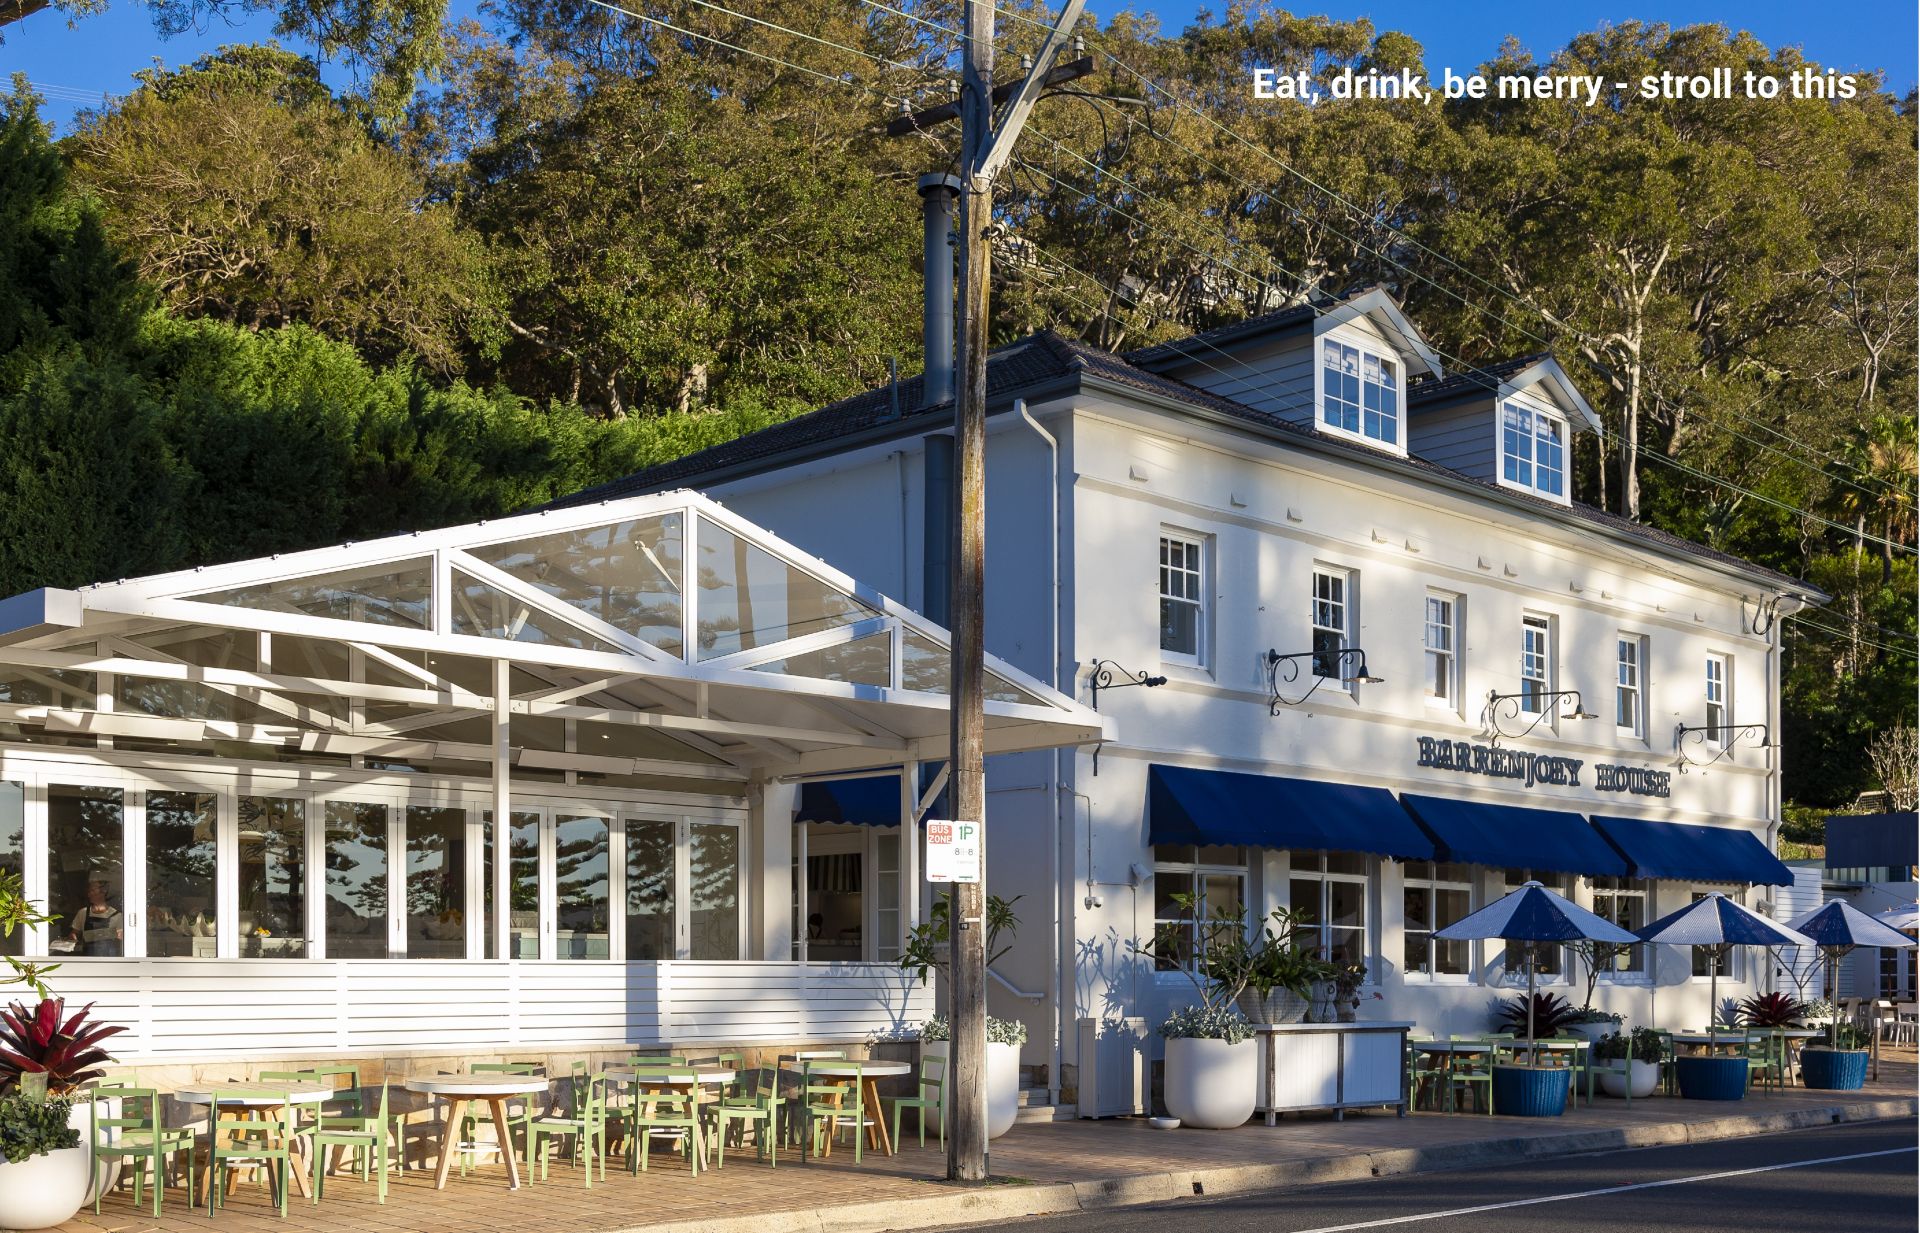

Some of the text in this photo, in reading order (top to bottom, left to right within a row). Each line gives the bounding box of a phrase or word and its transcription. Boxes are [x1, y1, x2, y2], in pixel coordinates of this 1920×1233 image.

[1417, 736, 1671, 798] BARRENJOEY HOUSE
[932, 825, 949, 834] BUS
[959, 826, 974, 840] 1P
[928, 834, 952, 843] ZONE
